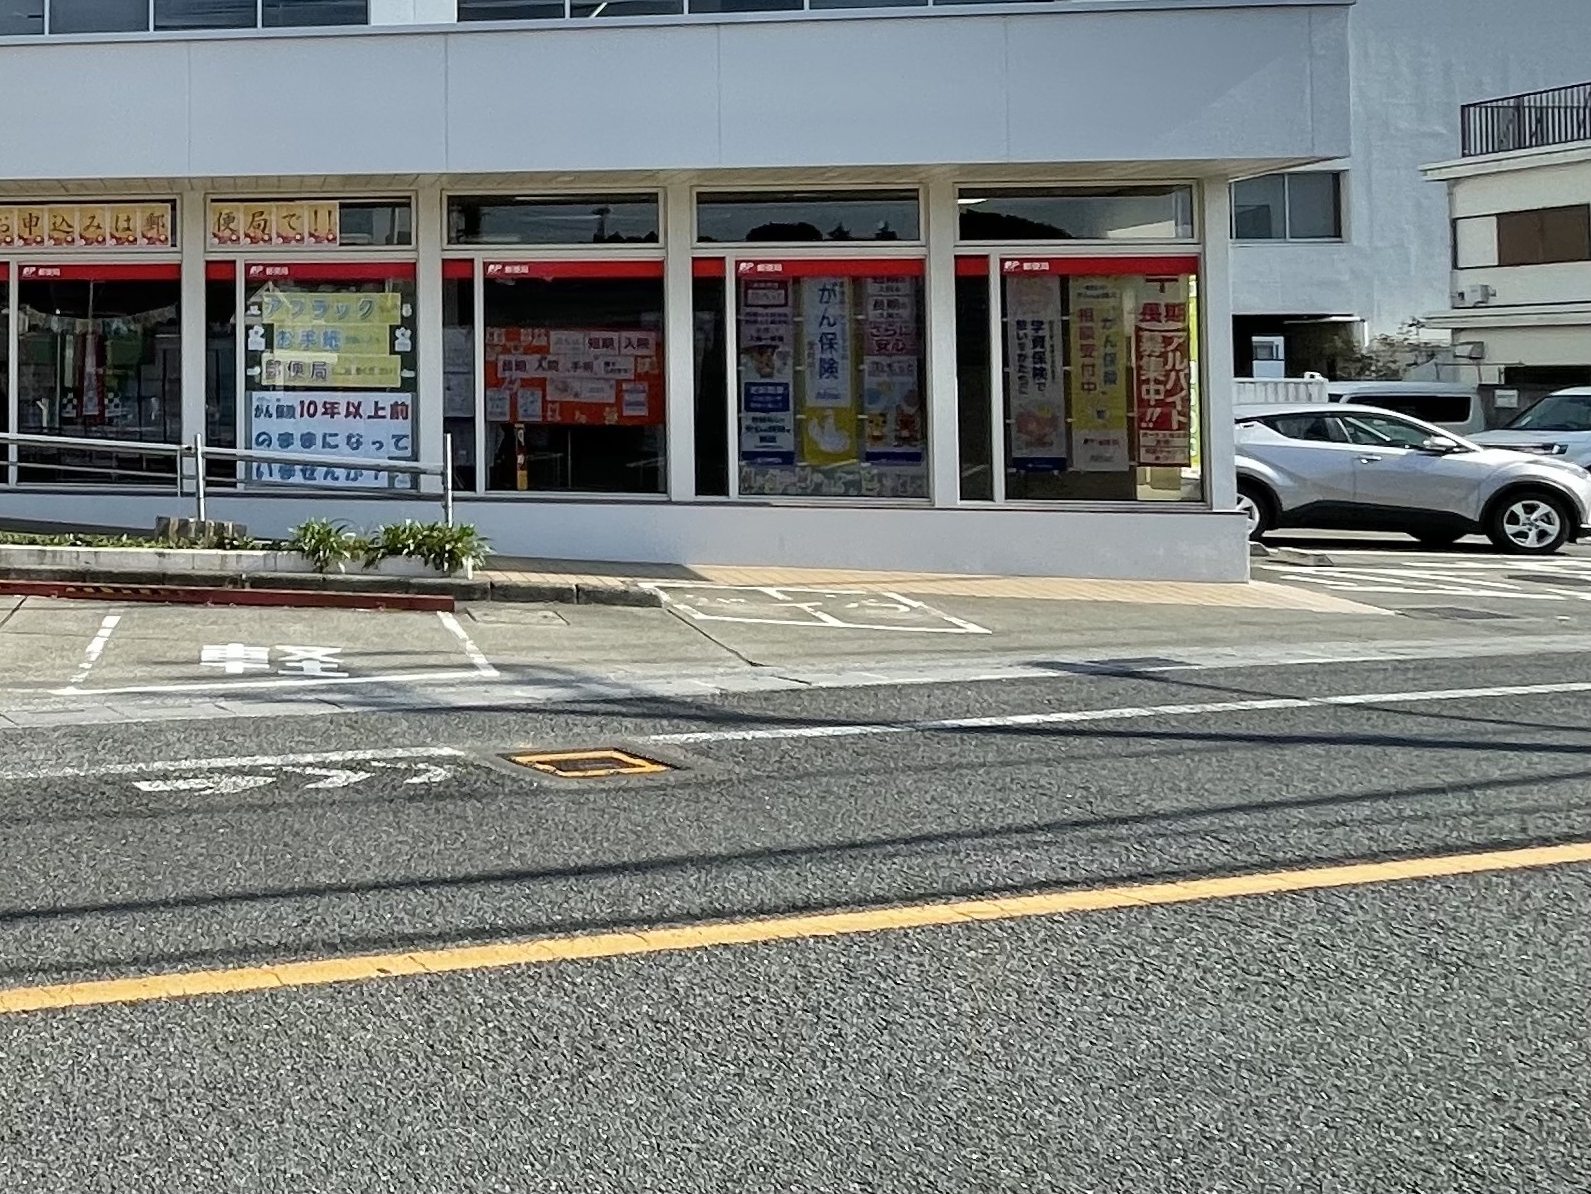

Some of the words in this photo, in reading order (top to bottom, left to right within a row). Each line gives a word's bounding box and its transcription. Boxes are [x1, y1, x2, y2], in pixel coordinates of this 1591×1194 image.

[817, 282, 839, 379] がん保険
[266, 360, 327, 380] 郵便局
[255, 431, 409, 451] のままになって
[200, 642, 349, 677] 軽
